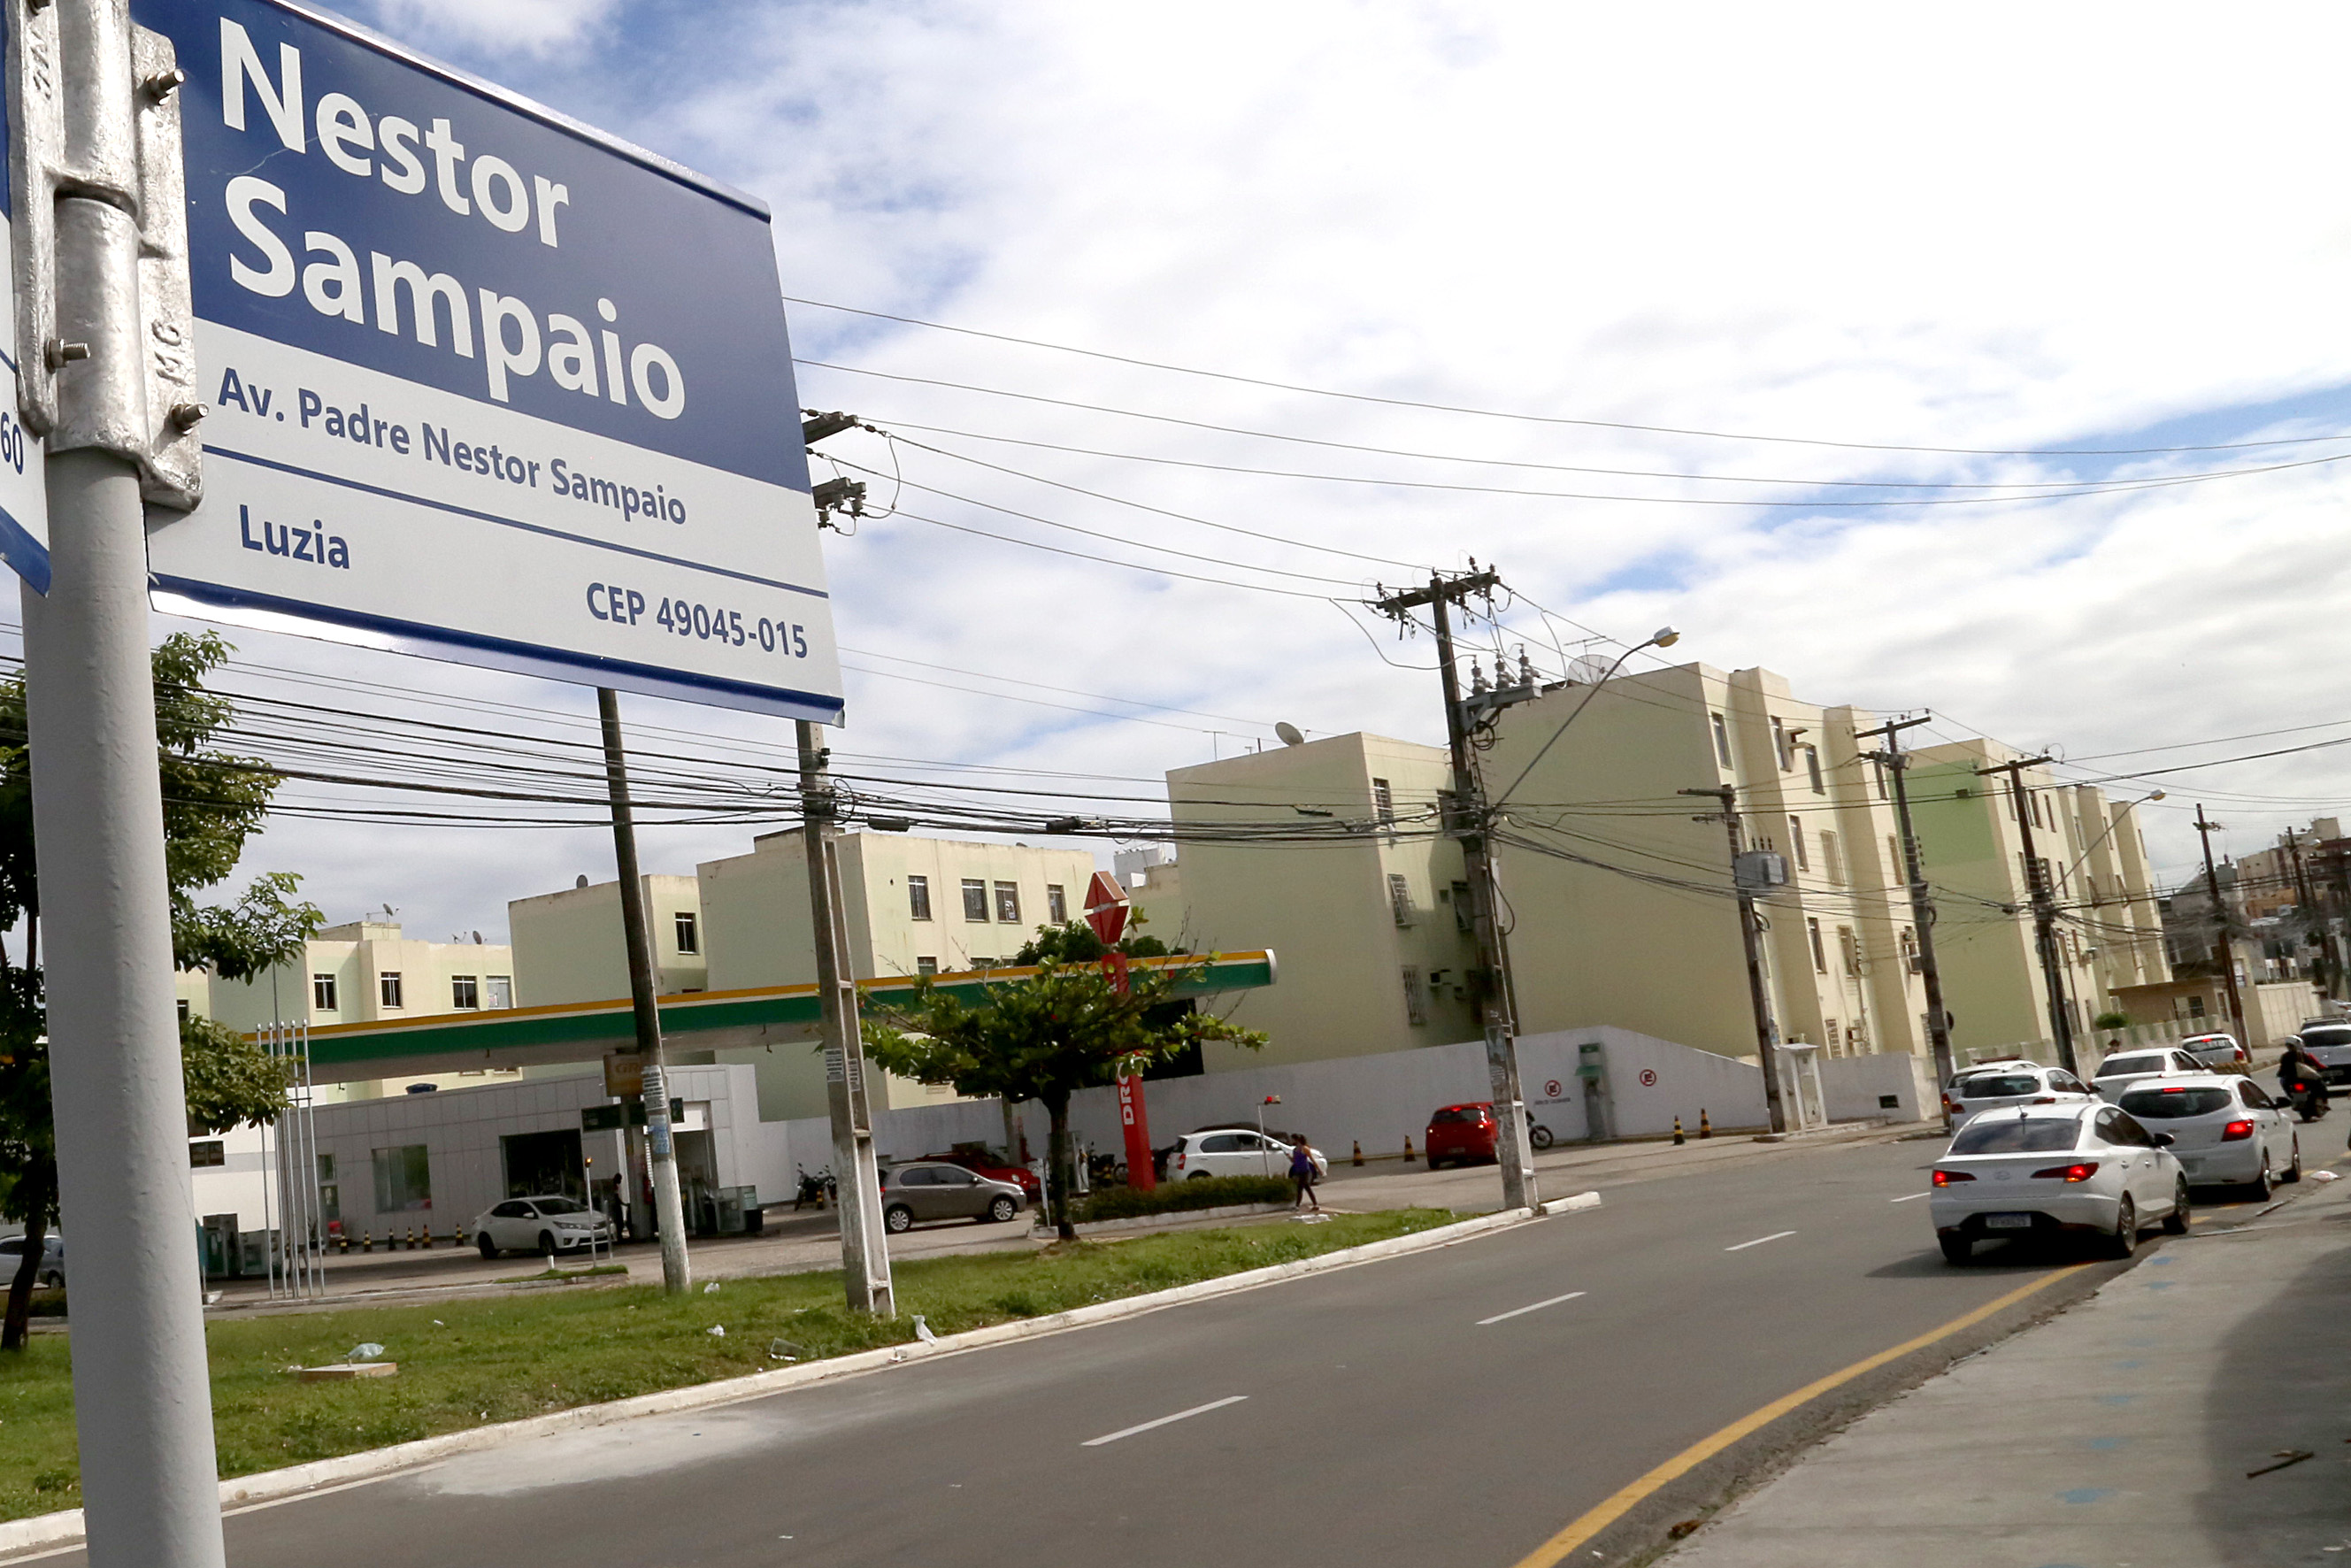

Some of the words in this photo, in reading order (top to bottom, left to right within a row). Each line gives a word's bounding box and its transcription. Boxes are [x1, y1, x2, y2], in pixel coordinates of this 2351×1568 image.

[219, 16, 569, 248] Nestor
[225, 175, 686, 420] Sampaio
[218, 367, 284, 421] Av.
[298, 388, 411, 454] Padre
[422, 422, 540, 488] Nestor
[550, 458, 687, 525] Sampaio
[240, 503, 350, 569] Luzia
[587, 582, 646, 626] CEP
[657, 597, 808, 658] 49045-015
